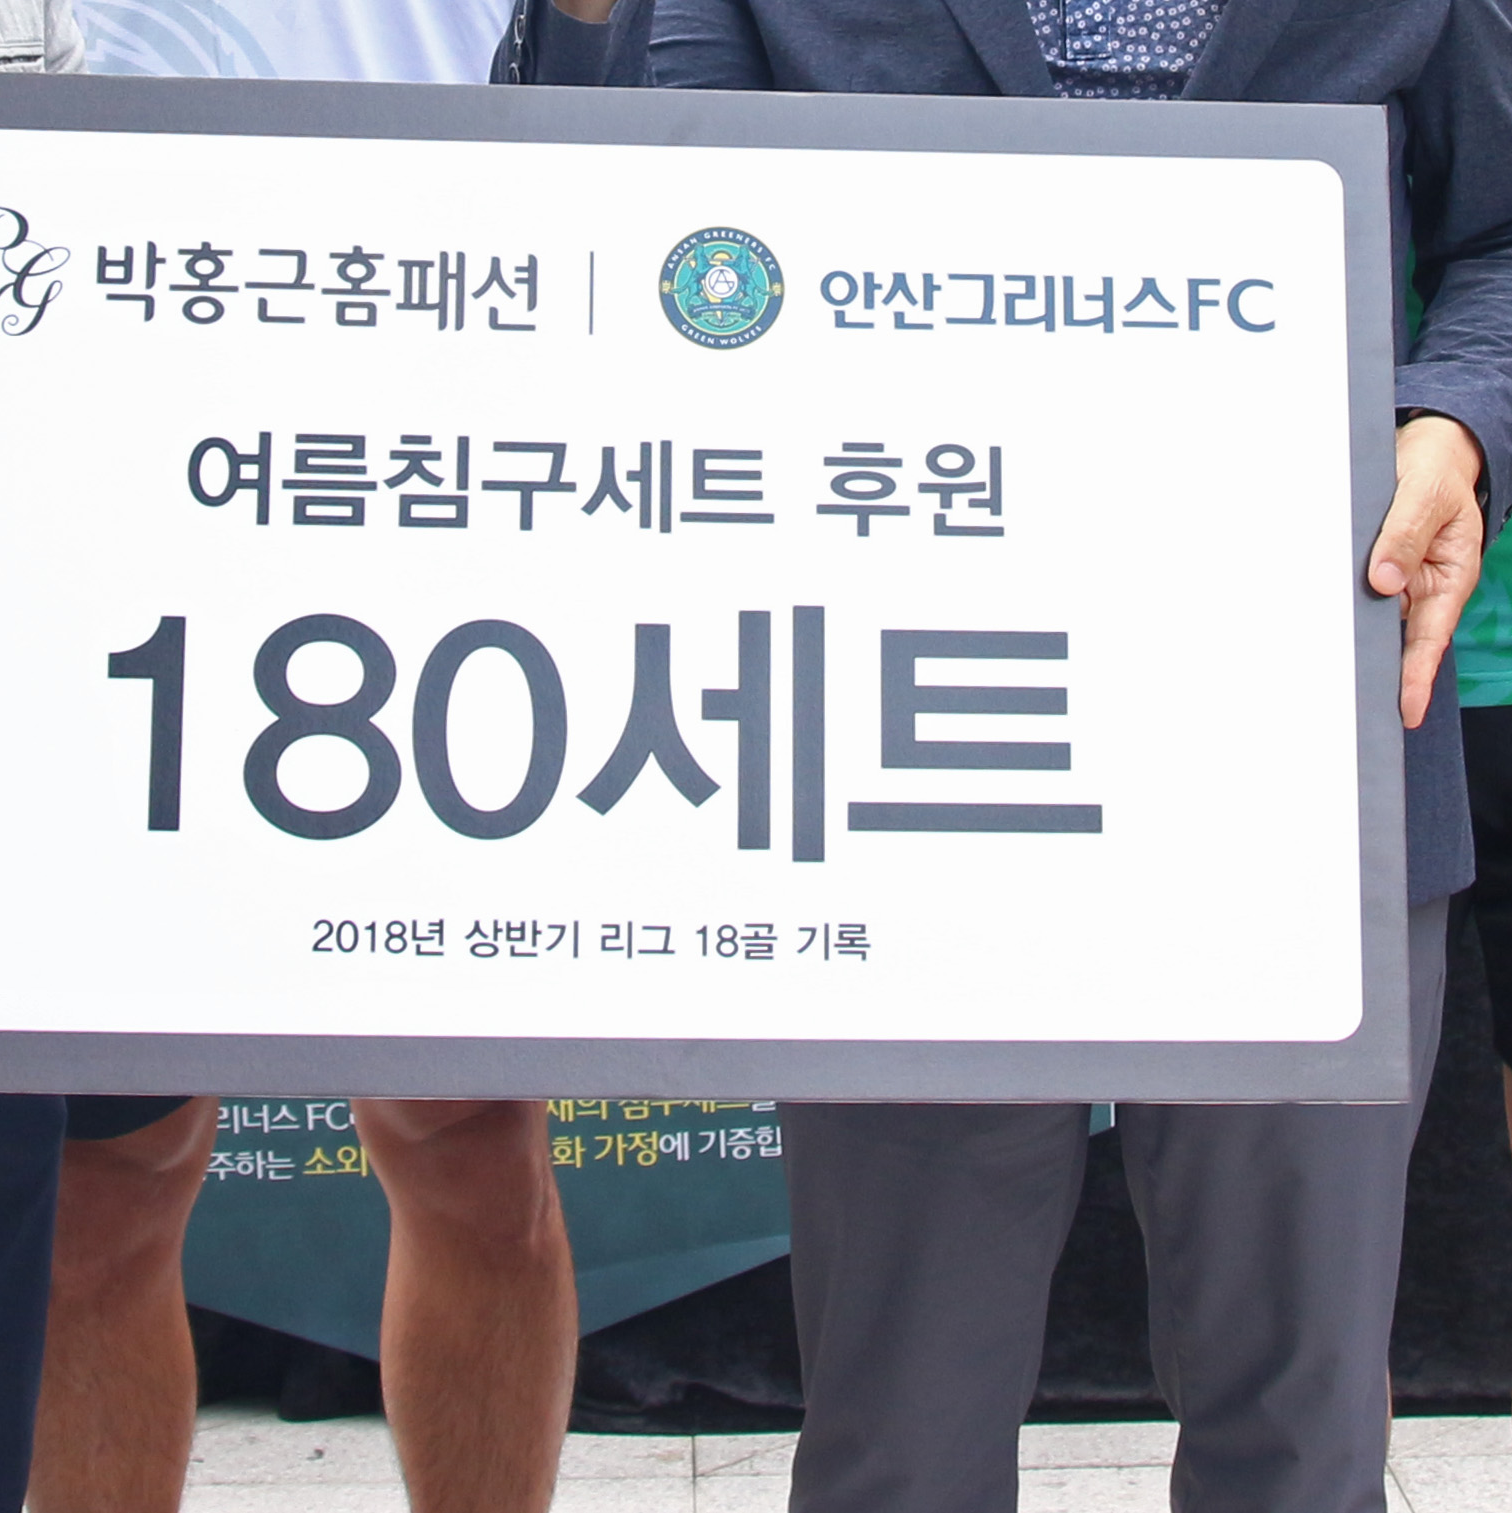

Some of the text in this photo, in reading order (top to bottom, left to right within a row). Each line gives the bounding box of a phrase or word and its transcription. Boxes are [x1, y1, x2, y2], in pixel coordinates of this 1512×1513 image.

[667, 236, 699, 270] ANSAN
[703, 230, 764, 254] GREENERS
[95, 240, 539, 332] 박홍근홈패션
[819, 270, 1277, 333] 안산그리너스FC
[680, 323, 763, 346] GREEN WOLVES
[186, 430, 1005, 538] 여름침구세트 후원
[106, 604, 1103, 863] 180세트
[311, 918, 872, 961] 2018년 상반기 리그 18골 기록
[217, 1102, 355, 1135] 리너스 FC
[203, 1149, 296, 1181] 주하는
[551, 1135, 586, 1169] 화
[594, 1131, 690, 1167] 가정에
